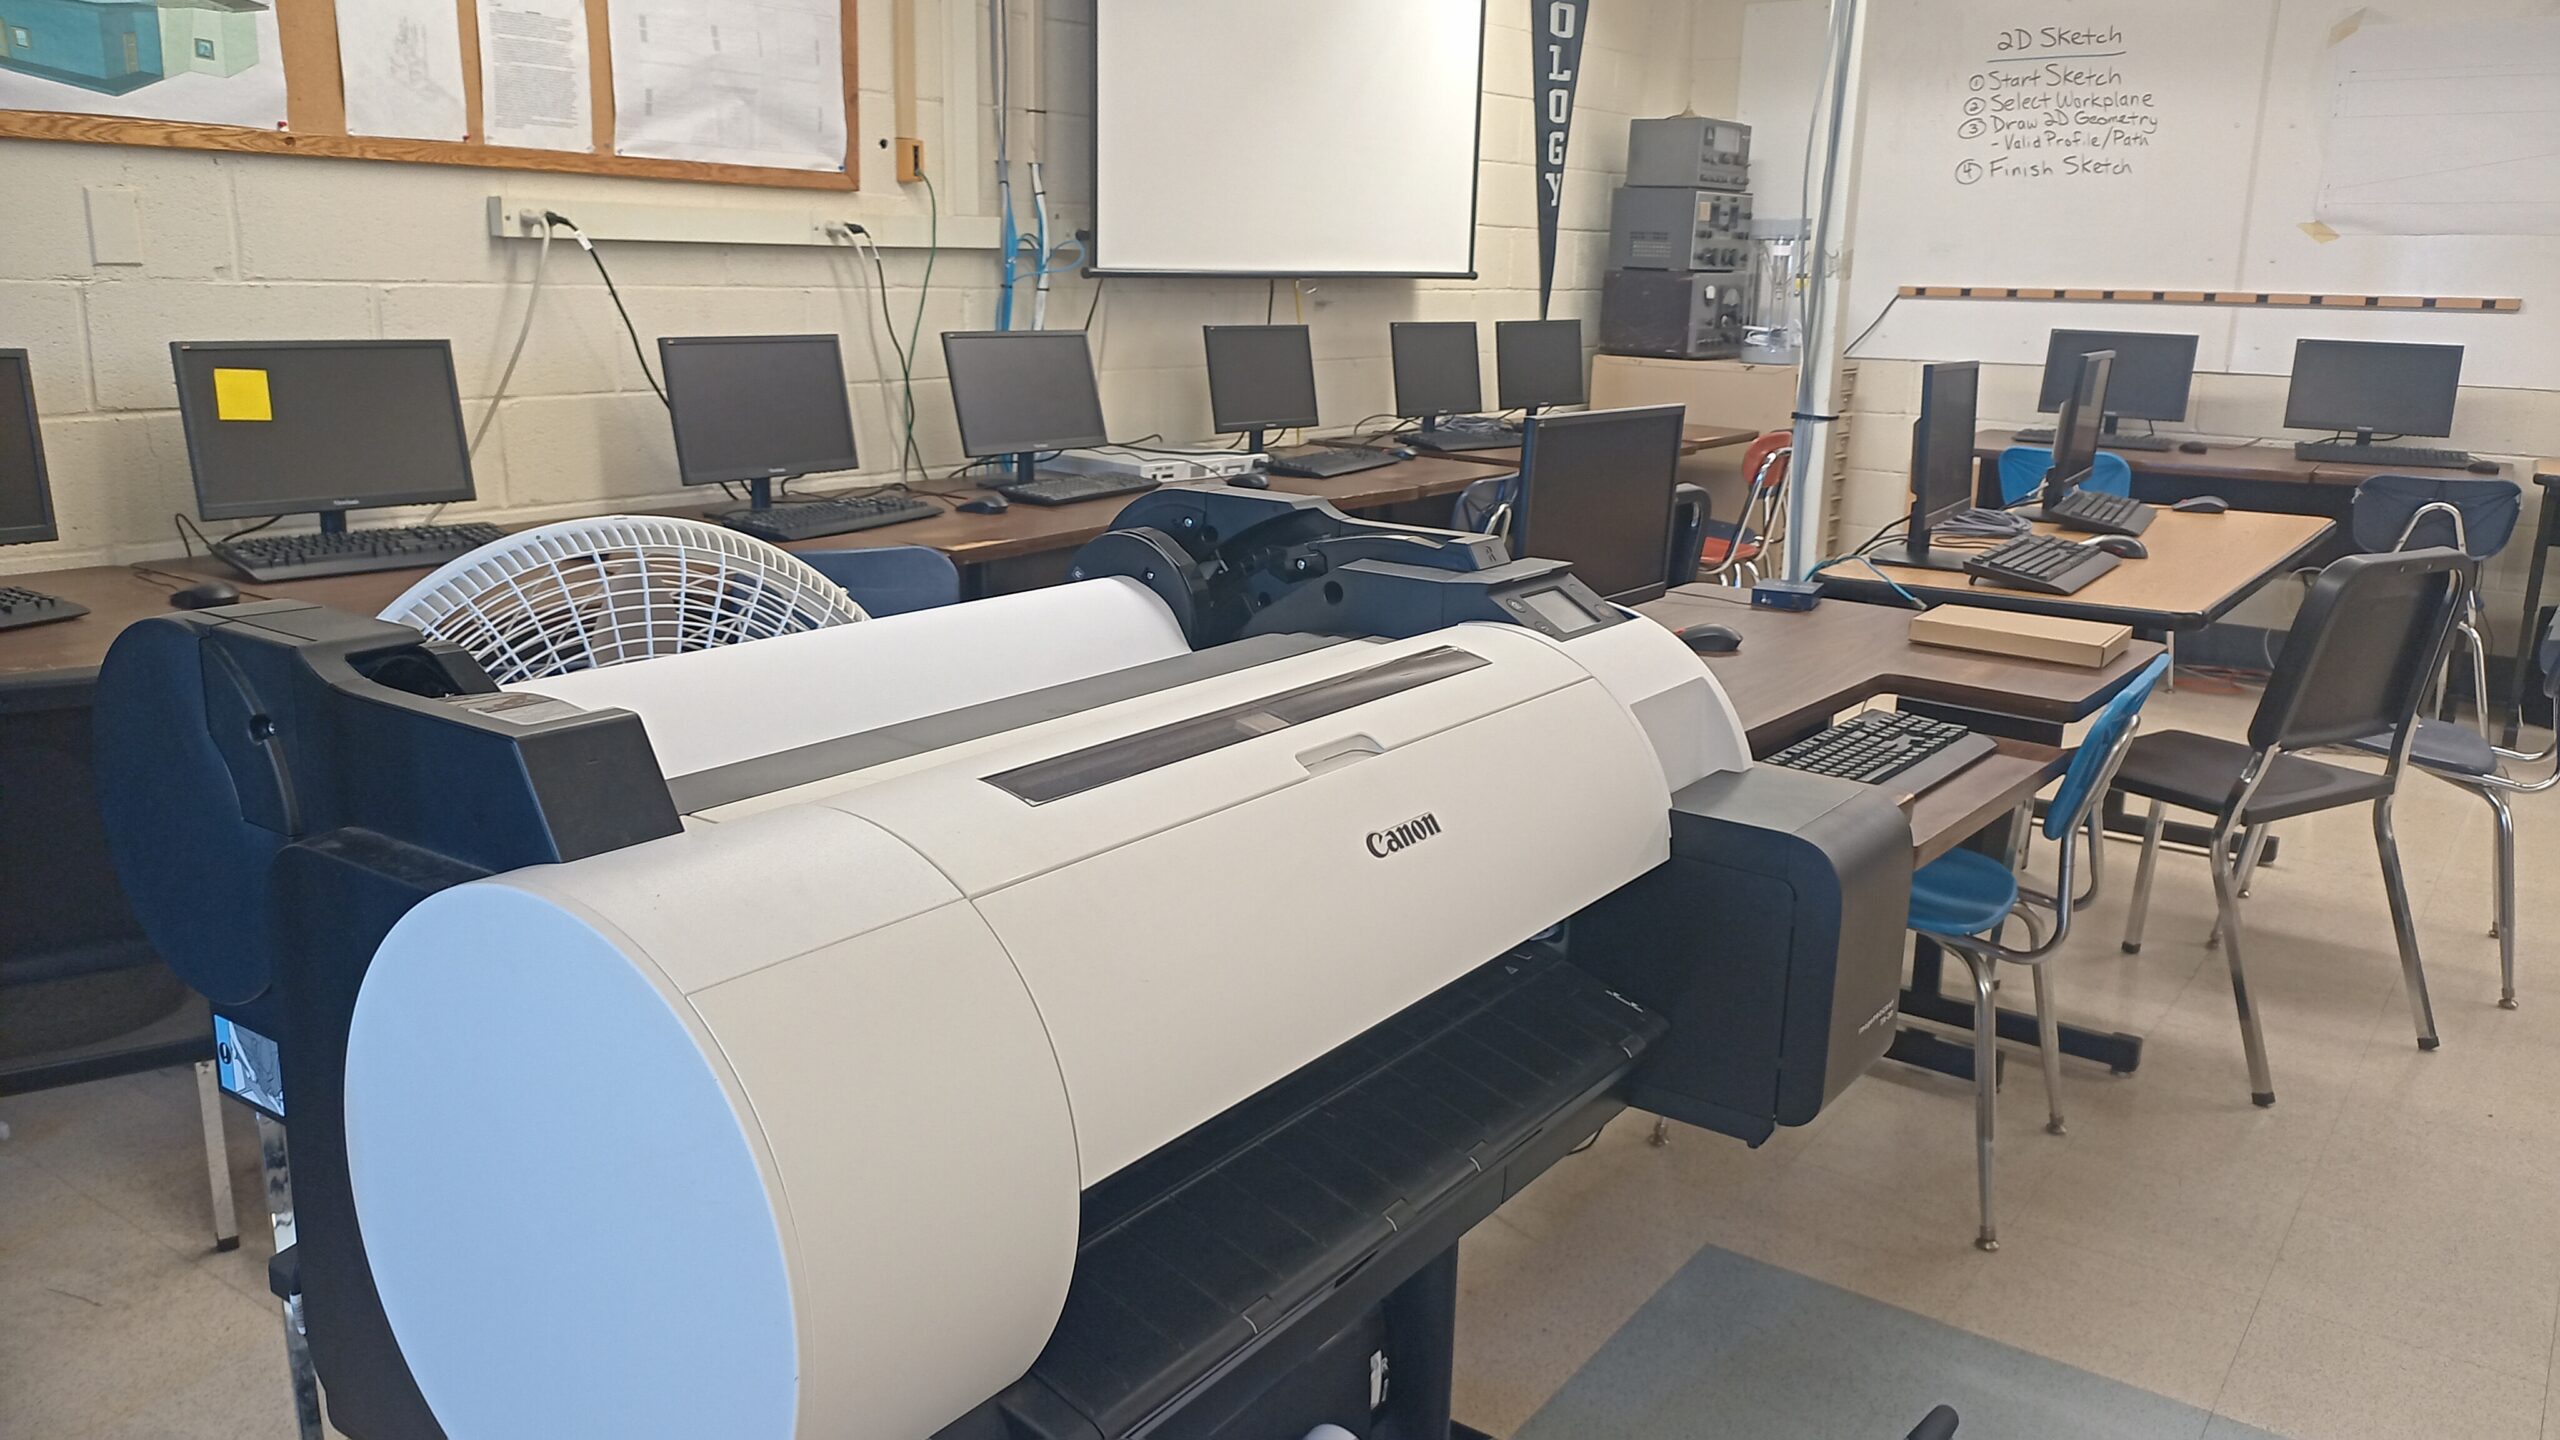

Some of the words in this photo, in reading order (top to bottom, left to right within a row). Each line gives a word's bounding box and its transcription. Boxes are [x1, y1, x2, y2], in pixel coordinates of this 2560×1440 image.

[1997, 28, 2032, 50] 2D
[2040, 25, 2122, 48] Sketch
[1988, 69, 2041, 90] Start
[2045, 63, 2122, 87] Sketch
[1544, 1, 1576, 207] OLOGY
[1991, 92, 2052, 112] Select
[2056, 91, 2155, 110] Workplane
[1990, 114, 2038, 134] Draw
[2043, 109, 2069, 127] 2D
[2074, 110, 2158, 134] Geometry
[2004, 134, 2041, 150] Valid
[1990, 156, 2053, 178] Finish
[2063, 153, 2133, 176] Sketch
[1366, 812, 1442, 859] Canon
